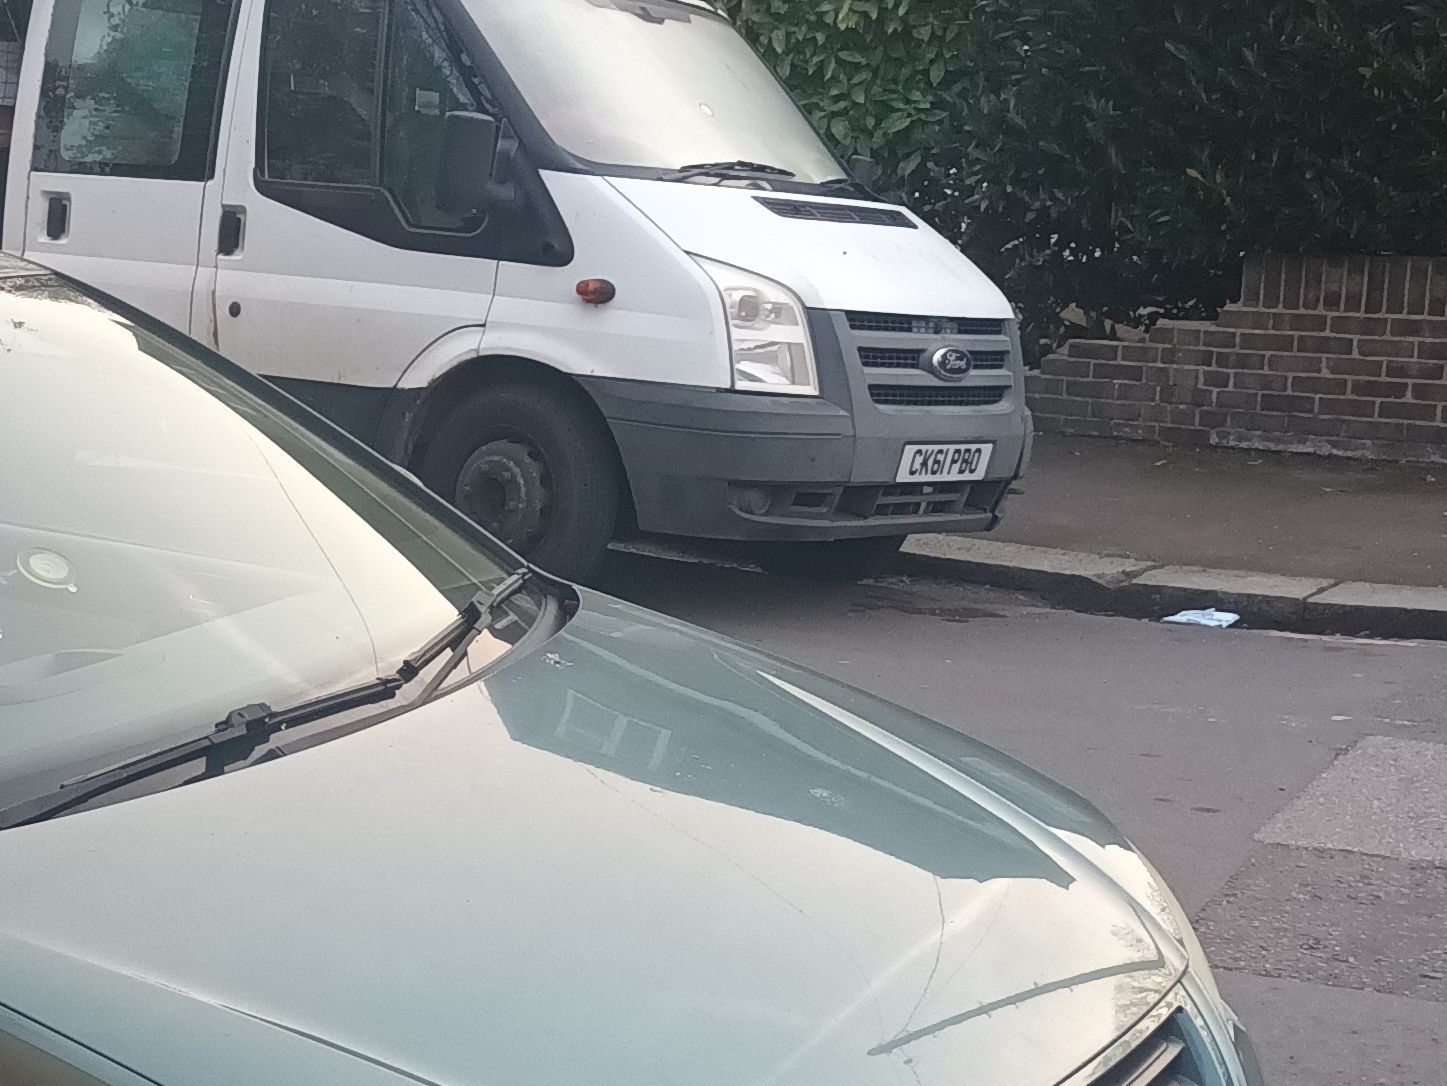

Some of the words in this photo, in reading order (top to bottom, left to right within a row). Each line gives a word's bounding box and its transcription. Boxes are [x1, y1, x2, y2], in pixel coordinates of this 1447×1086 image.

[946, 351, 967, 369] Ford
[909, 448, 949, 475] CK61
[947, 447, 982, 475] PBO
